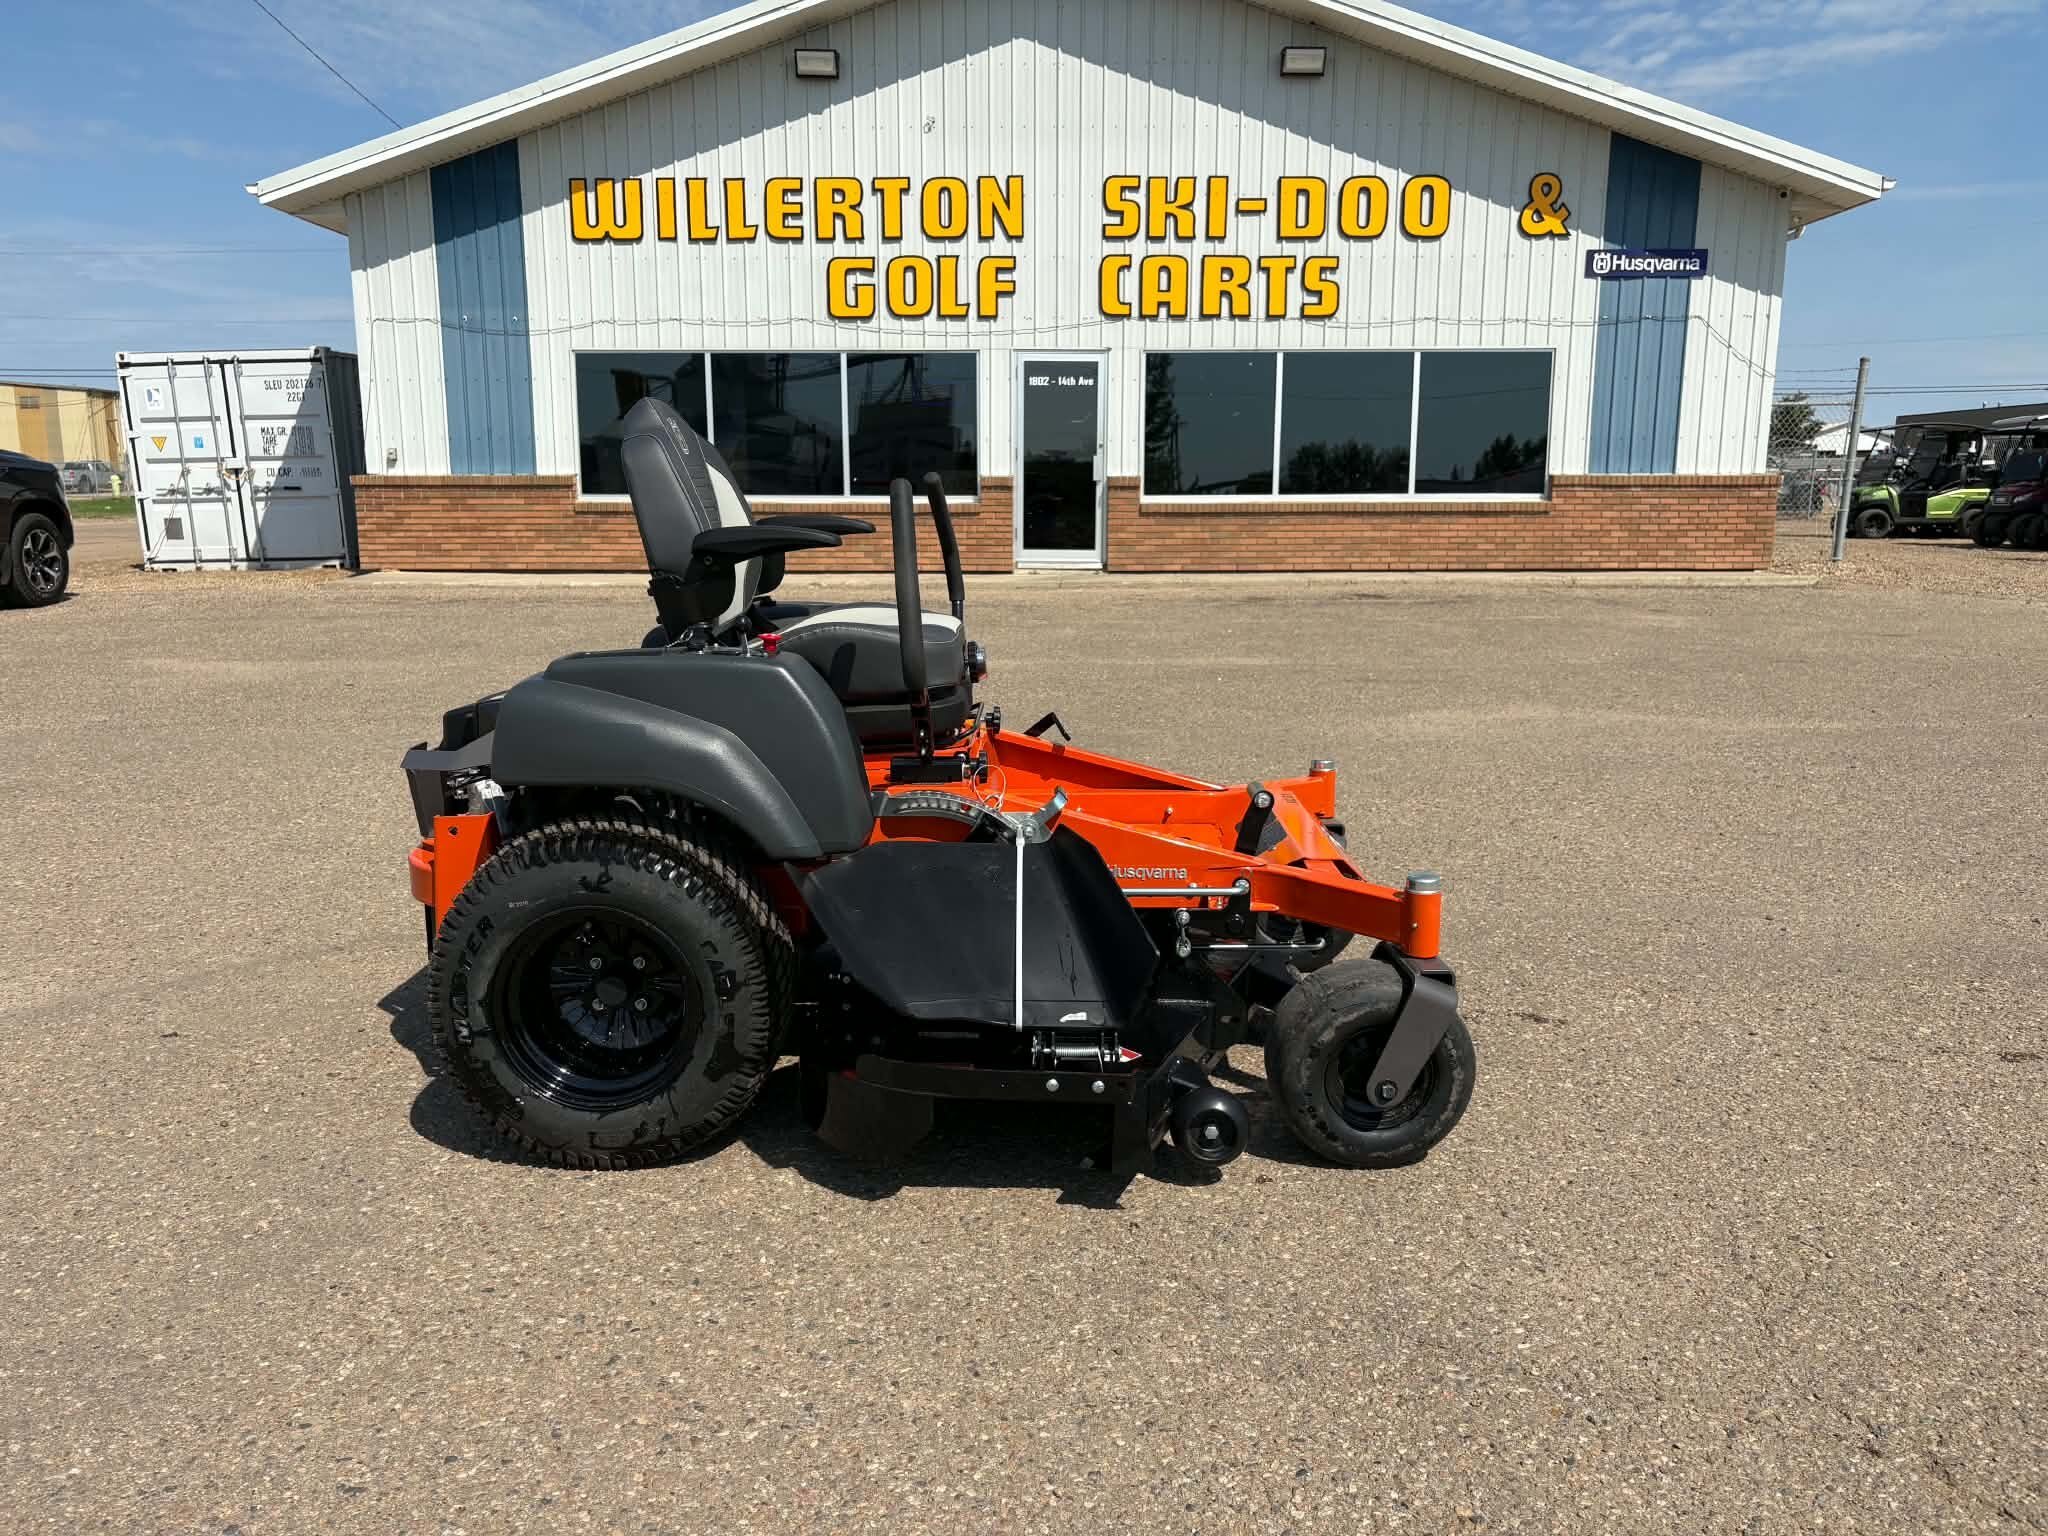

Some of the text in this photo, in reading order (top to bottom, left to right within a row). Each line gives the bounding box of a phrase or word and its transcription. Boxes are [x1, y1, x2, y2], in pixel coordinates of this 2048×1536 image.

[568, 173, 1572, 241] WILLERTON SKI-DOO &
[1612, 254, 1700, 273] Husqvarna
[827, 254, 1340, 320] GOLF CARTS
[1029, 376, 1050, 386] 1802
[1078, 376, 1094, 386] Ave
